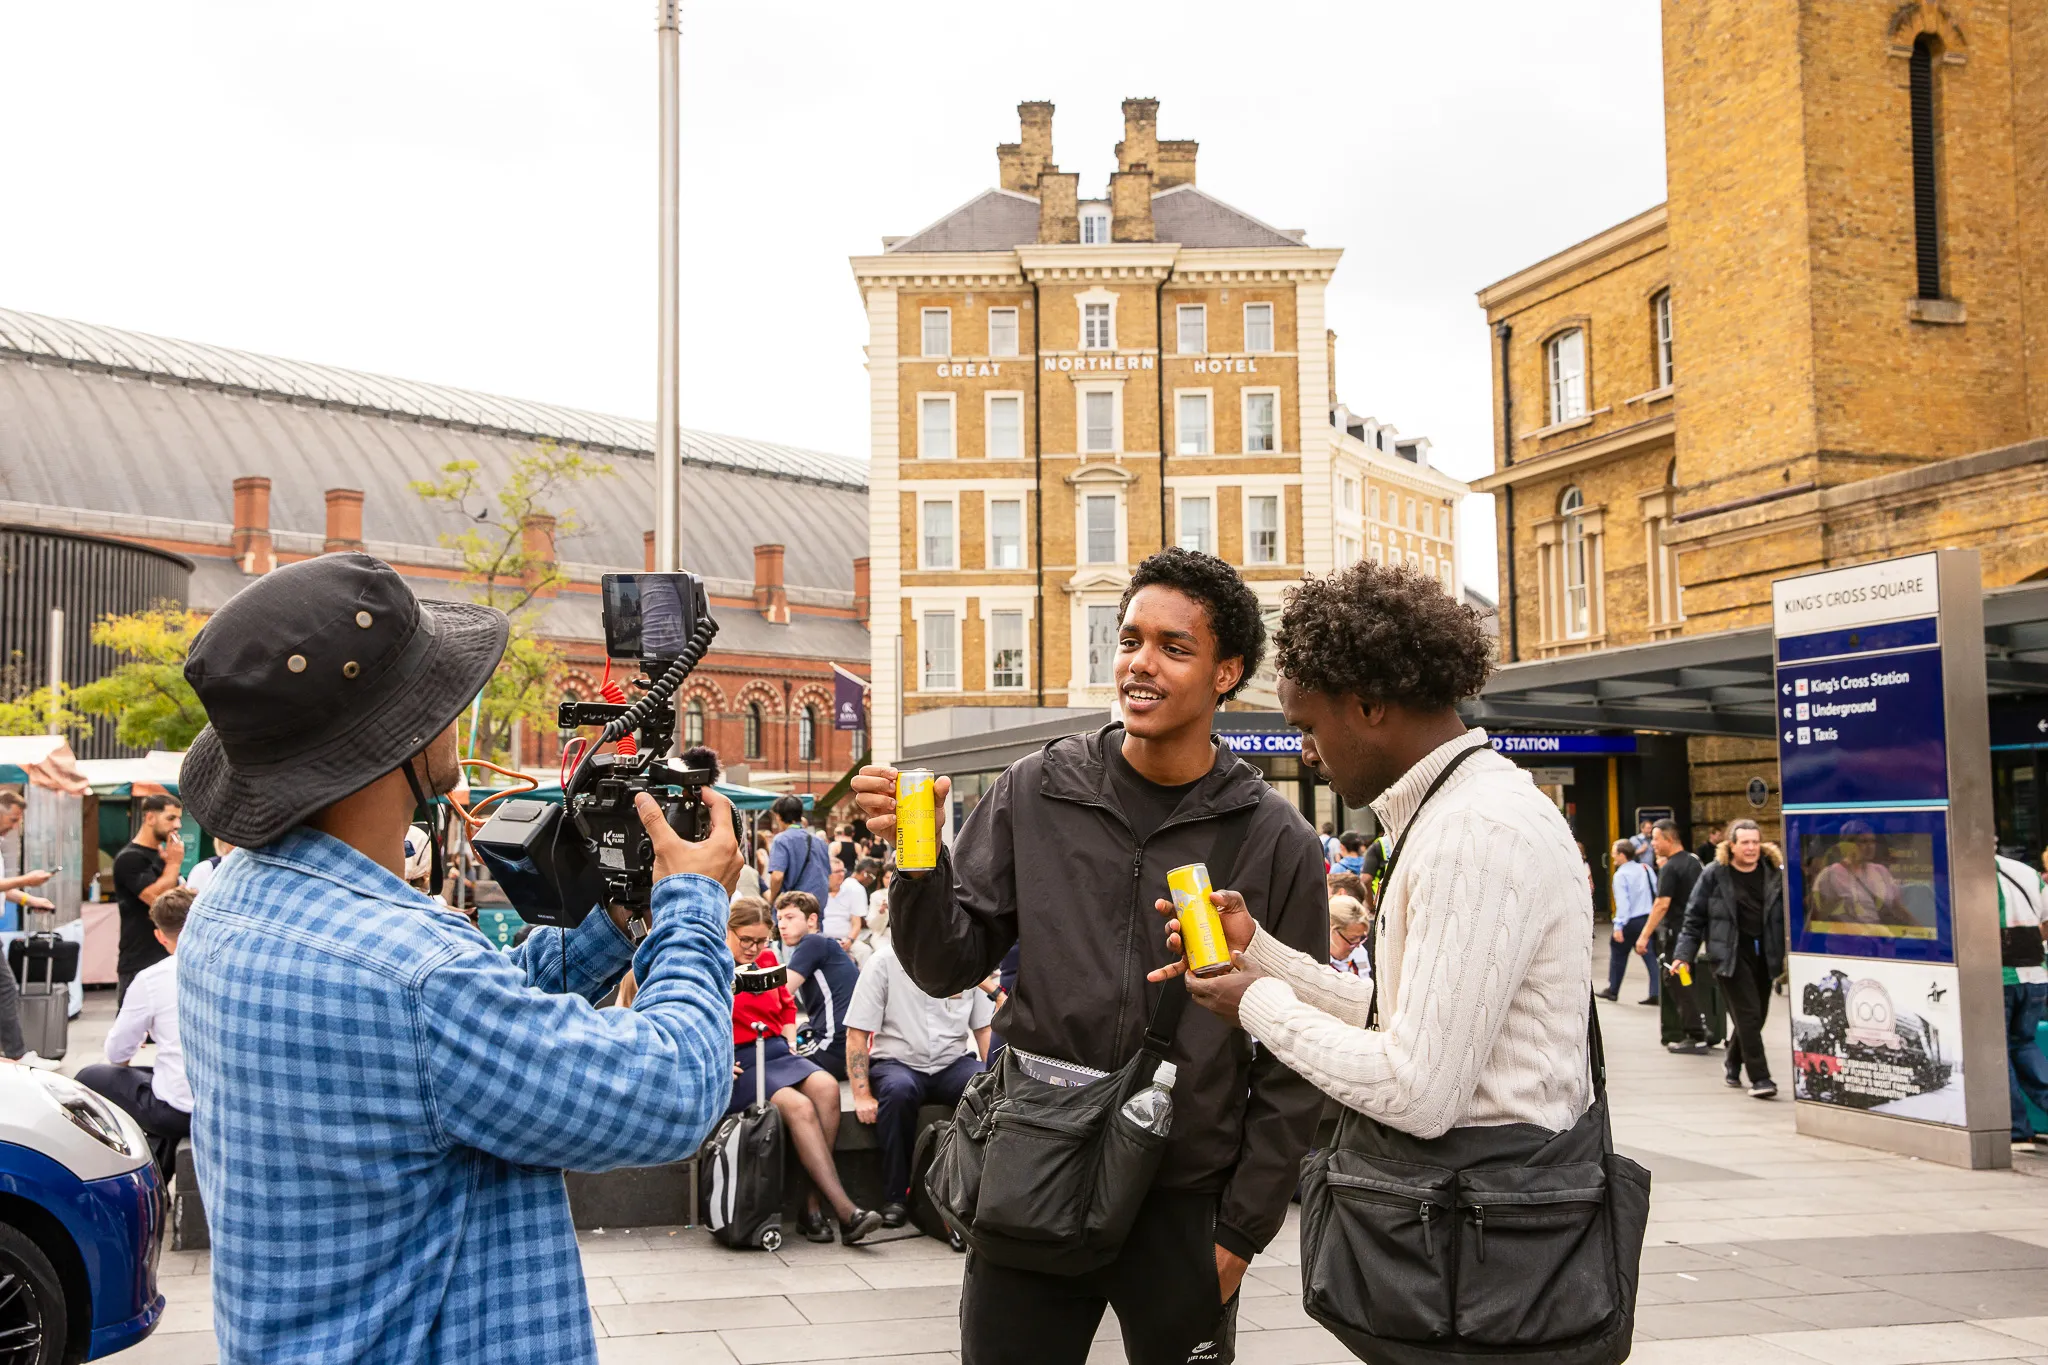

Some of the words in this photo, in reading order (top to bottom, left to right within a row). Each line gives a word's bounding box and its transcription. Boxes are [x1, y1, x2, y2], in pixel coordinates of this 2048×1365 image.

[937, 362, 1001, 377] GREAT
[1044, 356, 1154, 371] NORTHERN
[1194, 360, 1258, 373] HOTEL
[1370, 524, 1445, 559] HOTEL
[1784, 594, 1823, 614] KING'S
[1827, 587, 1867, 607] CROSS
[1871, 578, 1924, 599] SQUARE
[1811, 677, 1840, 694] King's
[1840, 676, 1869, 690] Cross
[1870, 671, 1909, 686] Station
[1811, 698, 1877, 717] Underground
[1223, 735, 1262, 751] ING'S
[1264, 736, 1302, 751] CROS
[1505, 737, 1559, 751] STATION
[1813, 727, 1838, 741] Taxis
[1199, 1352, 1218, 1360] MAX
